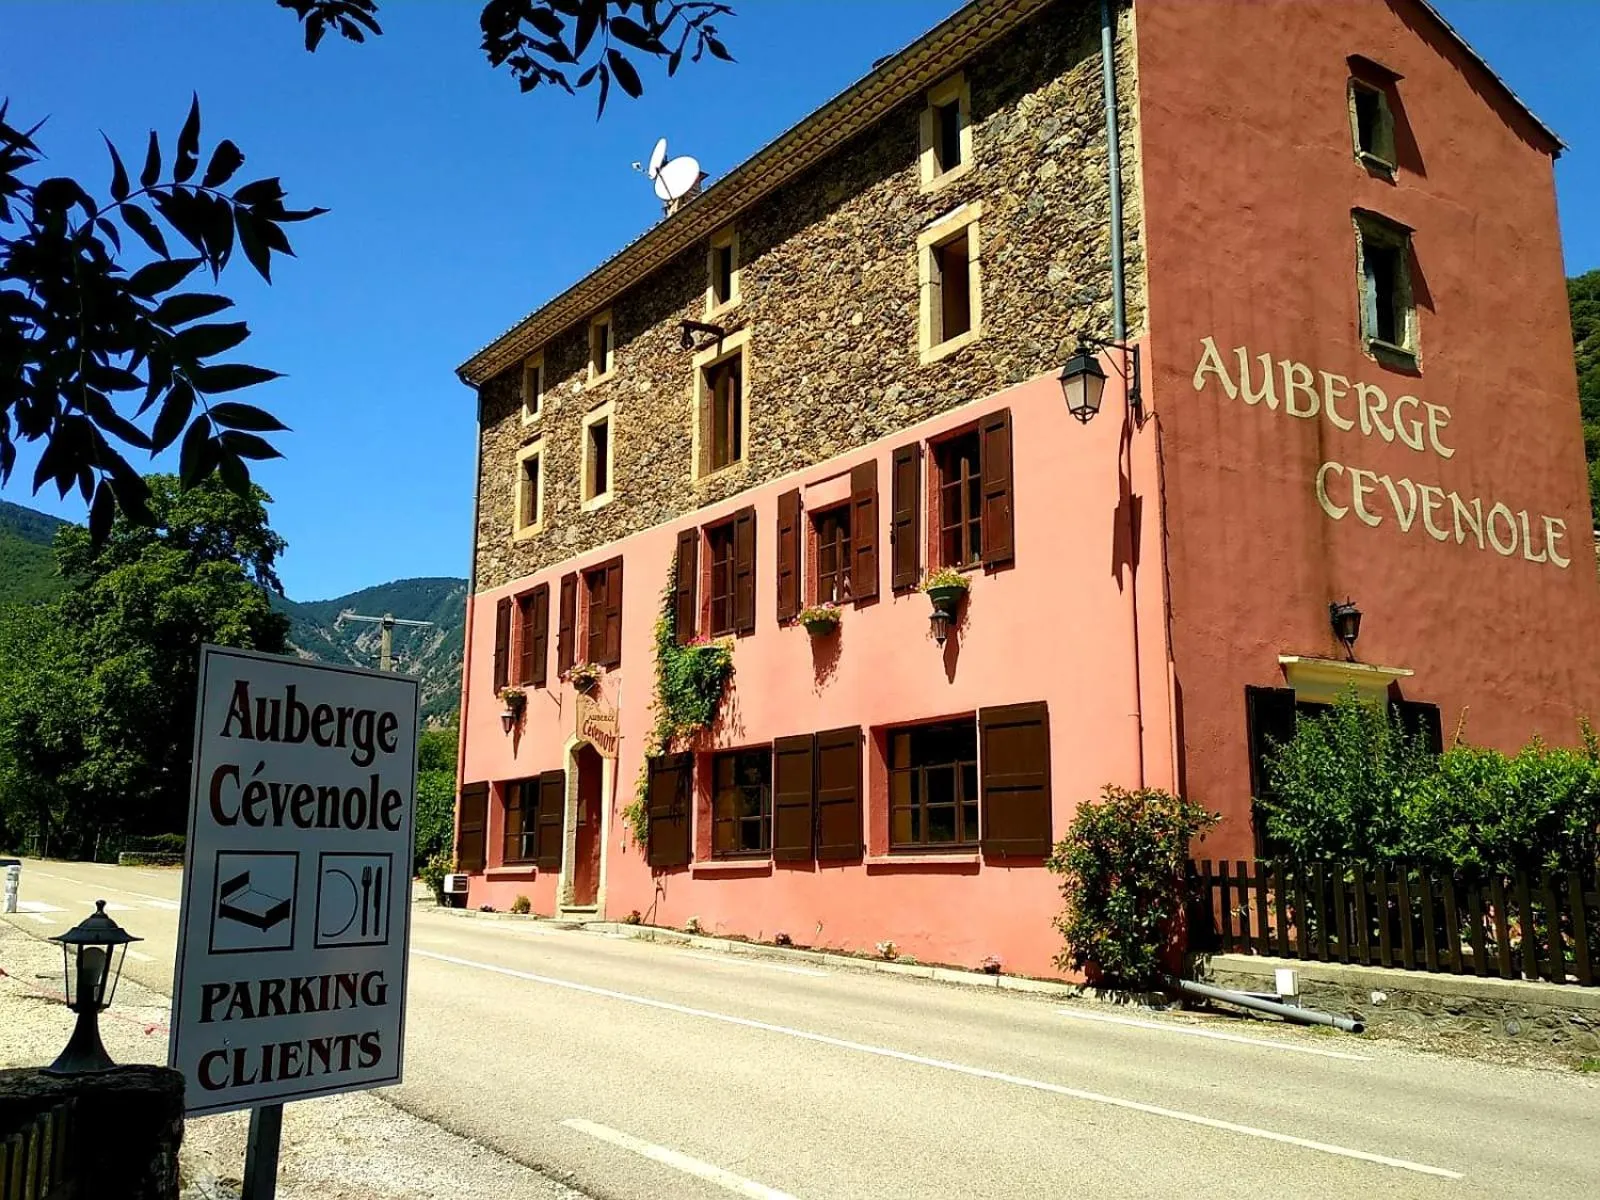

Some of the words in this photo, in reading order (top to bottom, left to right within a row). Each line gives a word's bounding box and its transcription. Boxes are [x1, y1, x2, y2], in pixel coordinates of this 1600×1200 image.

[1192, 336, 1456, 459] AUBERGE
[1316, 462, 1571, 568] CEVENOLE
[219, 680, 398, 767] Auberge
[210, 762, 402, 831] Cévenole
[200, 970, 387, 1023] PARKING
[198, 1031, 382, 1091] CLIENTS
